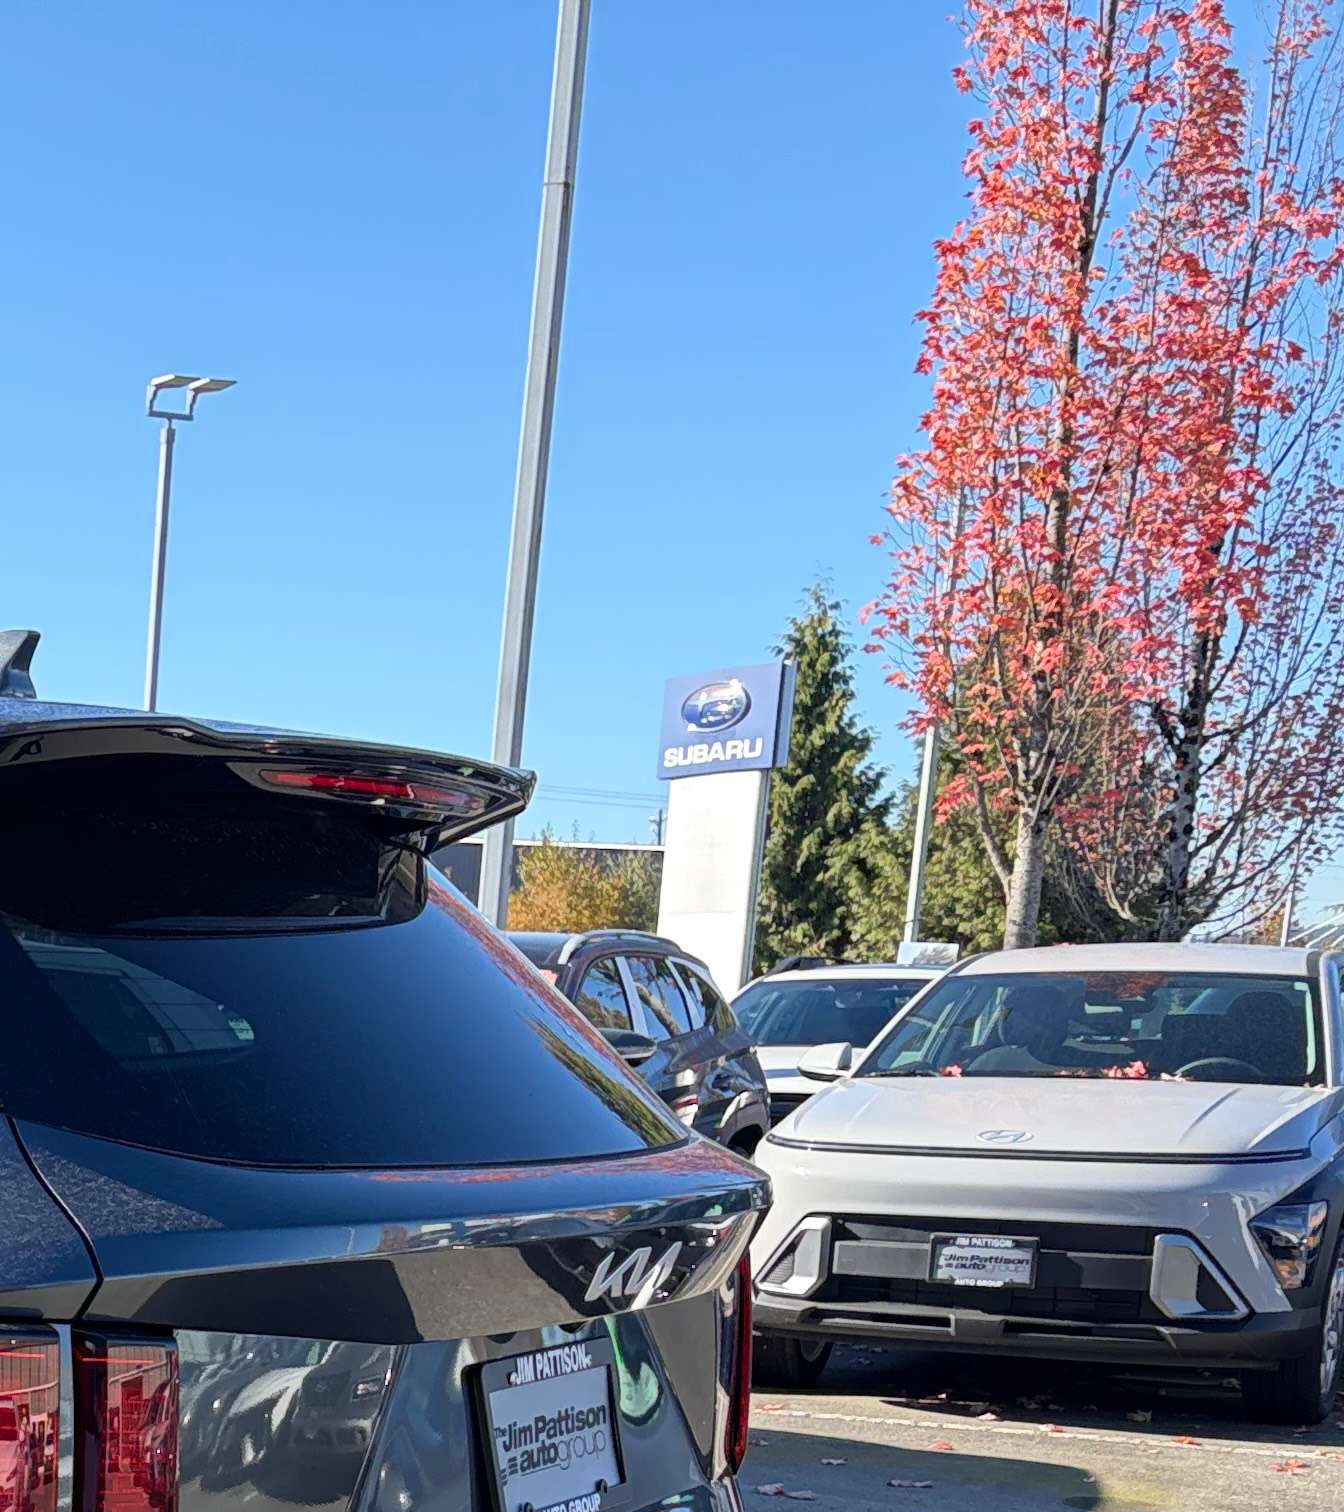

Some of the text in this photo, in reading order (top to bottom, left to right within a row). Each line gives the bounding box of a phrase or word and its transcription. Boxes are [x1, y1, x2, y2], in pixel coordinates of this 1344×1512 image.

[663, 737, 763, 768] SUBARU
[516, 1344, 586, 1385] JIM PATTISON
